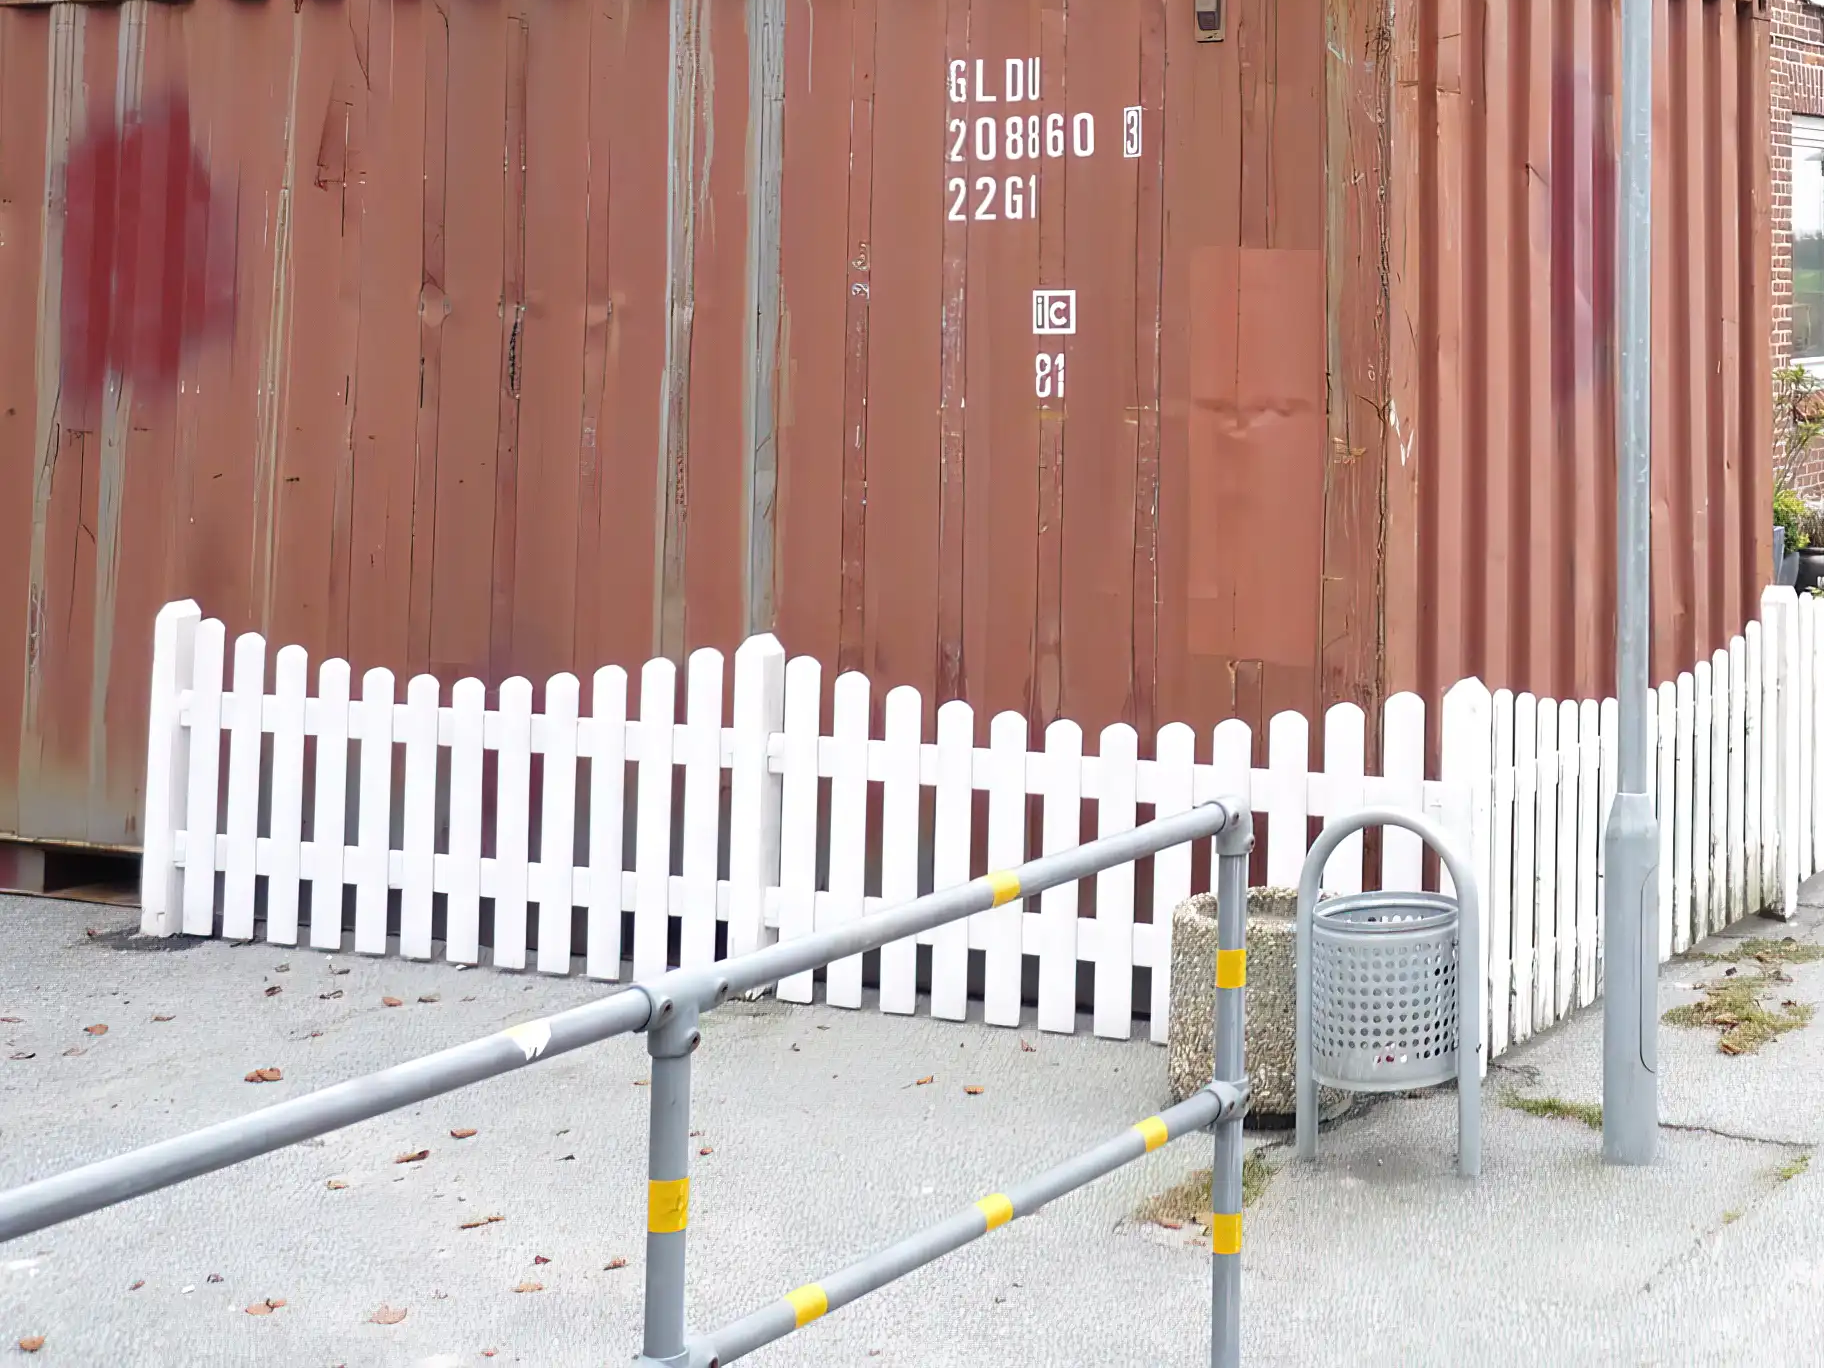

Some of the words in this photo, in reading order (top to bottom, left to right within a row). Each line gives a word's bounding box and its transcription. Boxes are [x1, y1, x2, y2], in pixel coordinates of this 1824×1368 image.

[948, 56, 1041, 102] GLDU
[948, 112, 1095, 162] 208860
[1125, 108, 1140, 156] 3
[948, 174, 1036, 221] 22G1
[1035, 352, 1065, 398] 81
